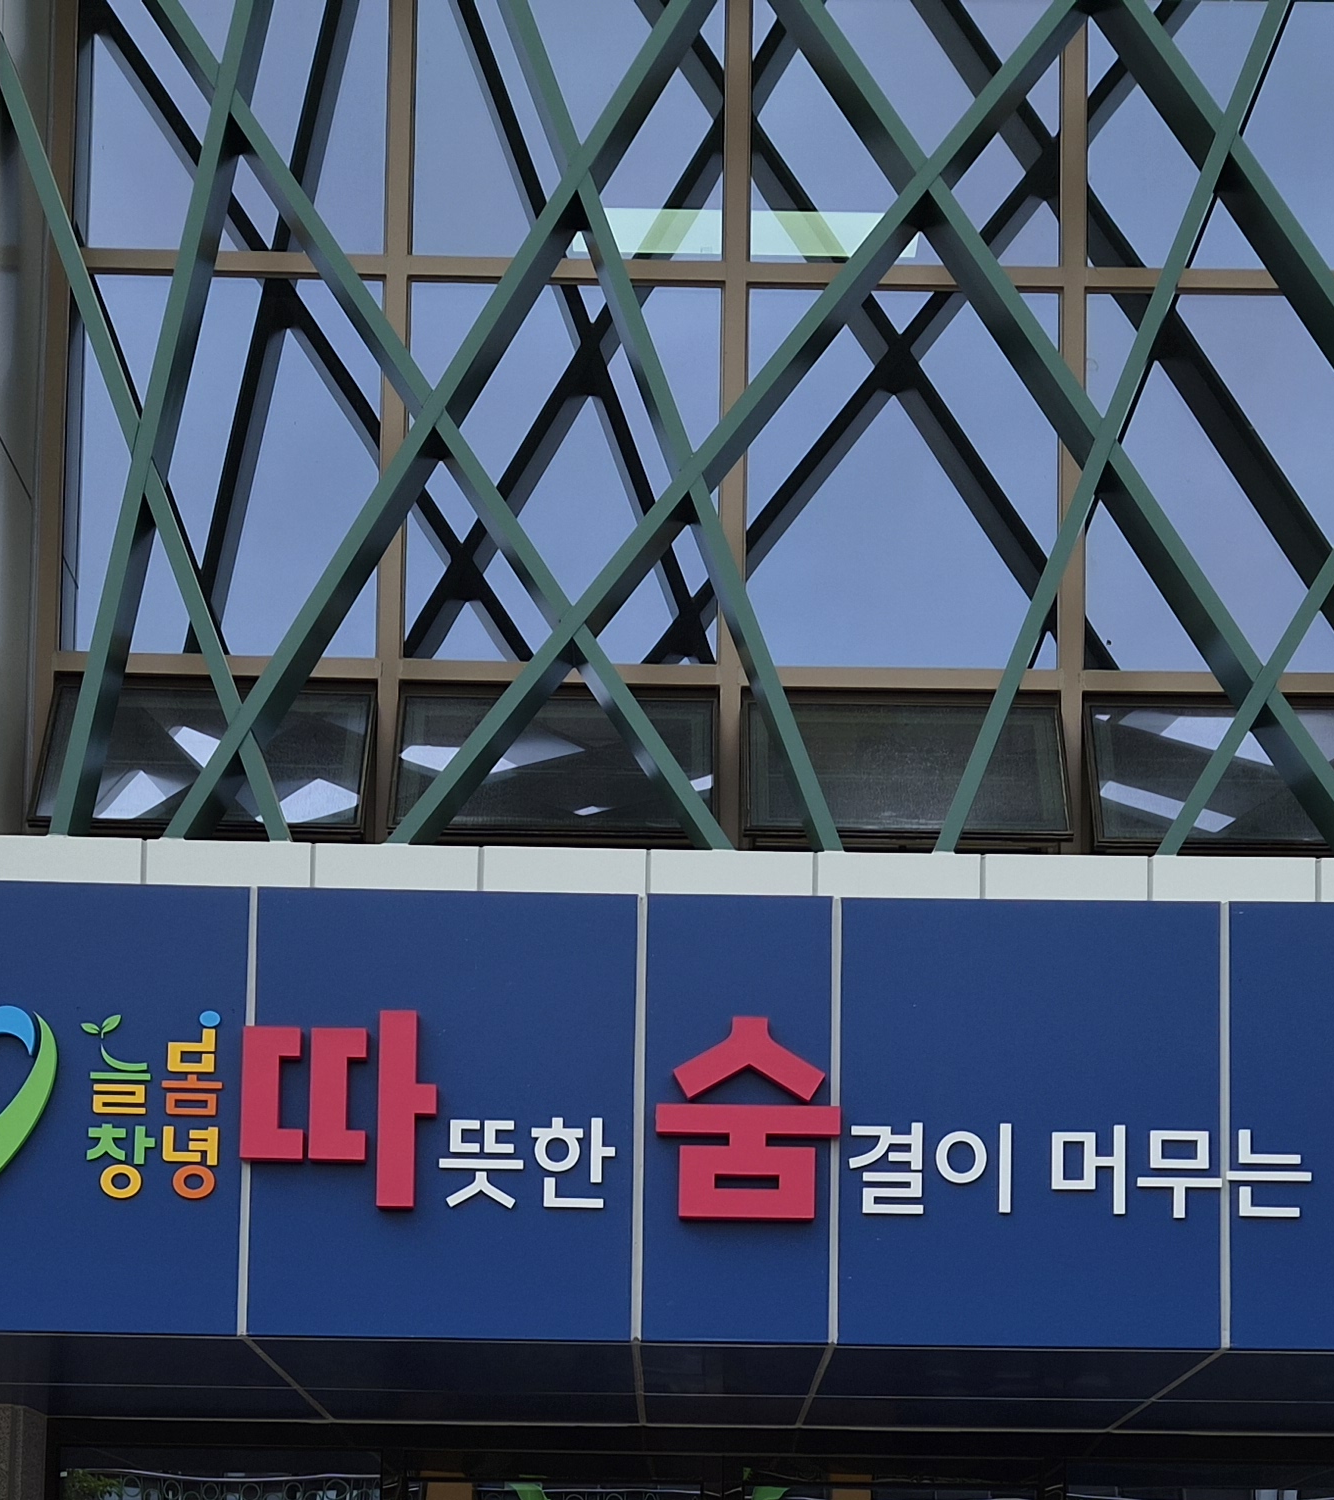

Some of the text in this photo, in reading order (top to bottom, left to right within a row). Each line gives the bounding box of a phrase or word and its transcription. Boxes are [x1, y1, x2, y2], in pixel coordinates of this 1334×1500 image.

[80, 1009, 224, 1116] 늘봄
[86, 1123, 220, 1199] 창녕
[1050, 1124, 1313, 1219] 머무는
